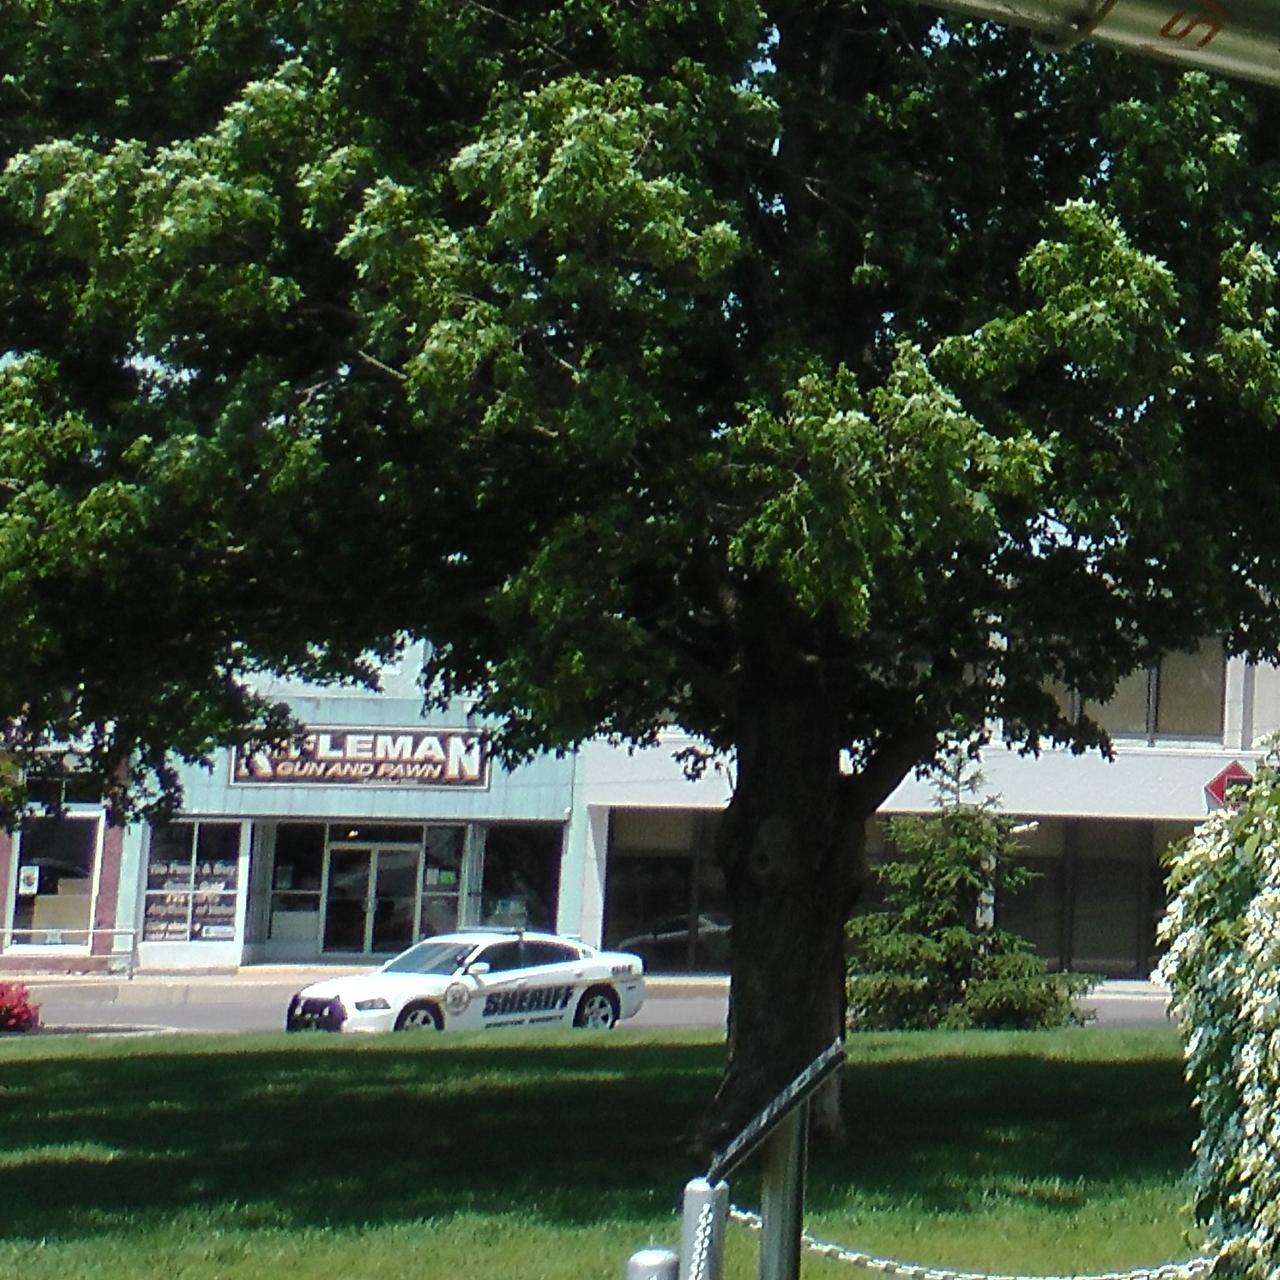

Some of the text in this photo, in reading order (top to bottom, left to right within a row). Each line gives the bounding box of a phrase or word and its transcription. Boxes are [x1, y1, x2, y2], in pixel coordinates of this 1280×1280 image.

[277, 762, 442, 778] GUN AND PAWN
[483, 984, 575, 1016] SHERIFF
